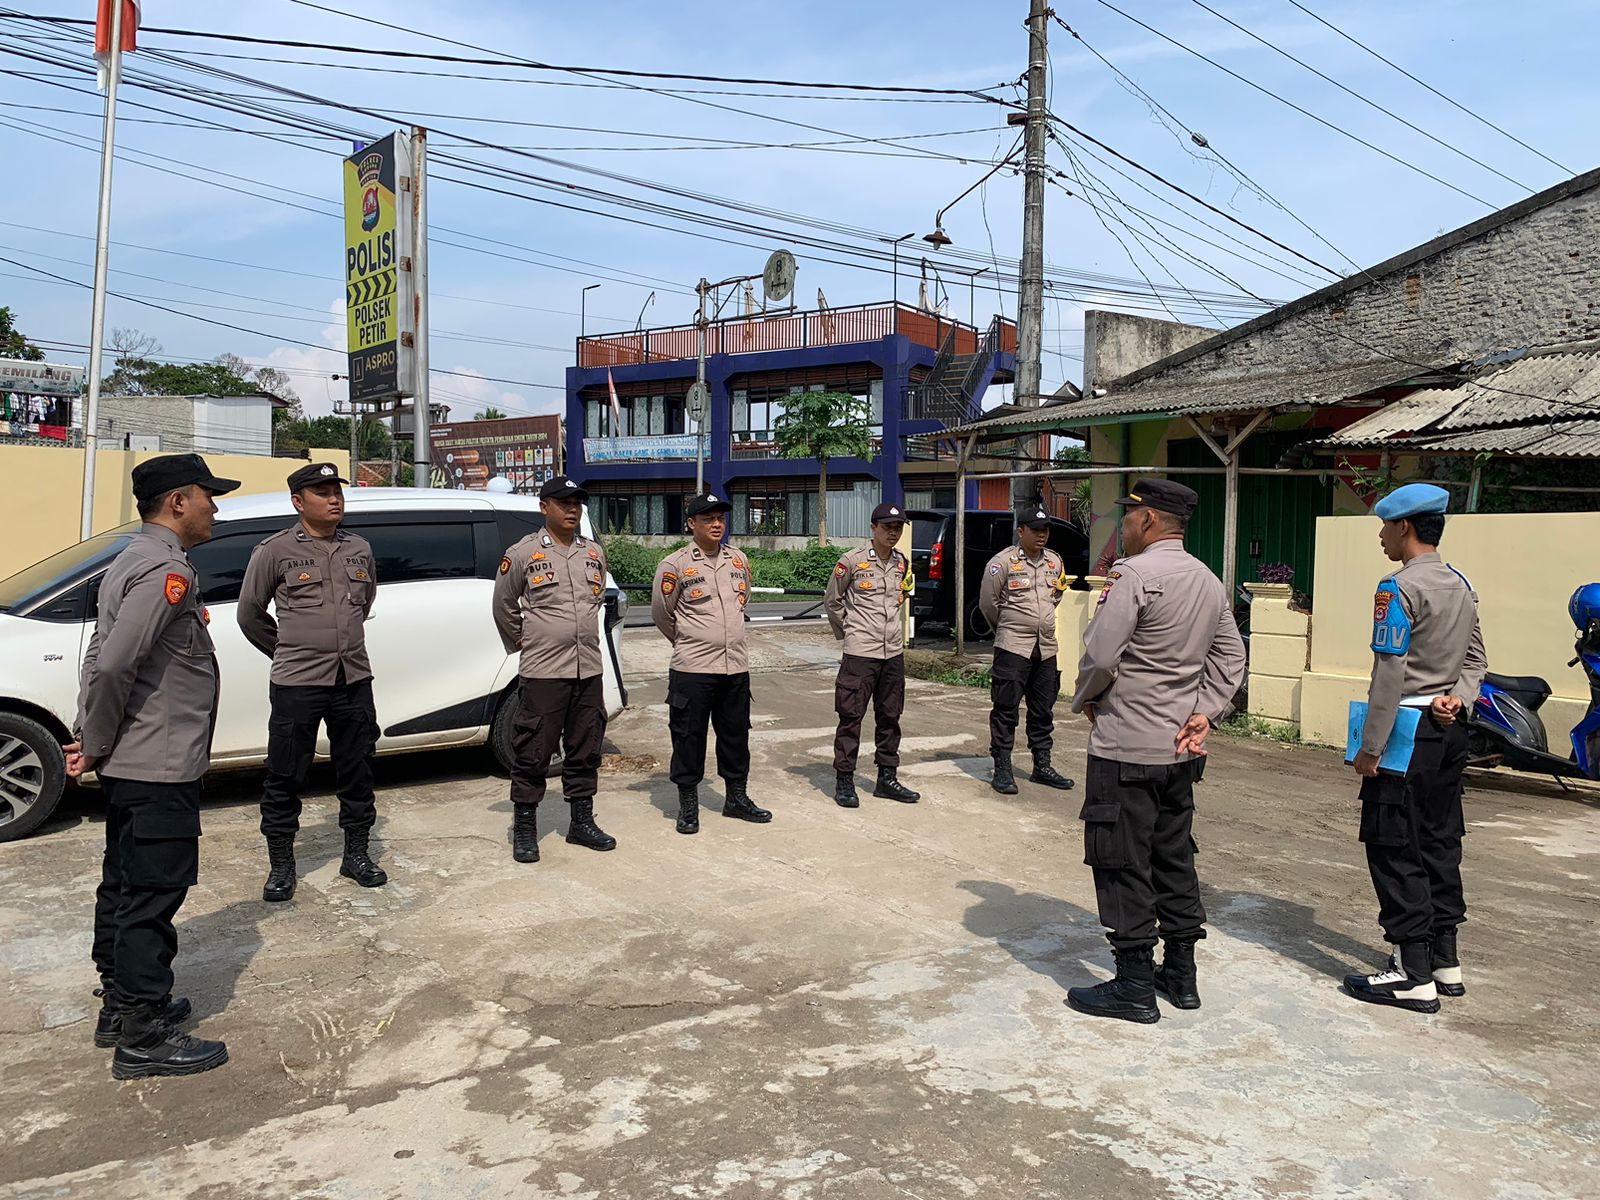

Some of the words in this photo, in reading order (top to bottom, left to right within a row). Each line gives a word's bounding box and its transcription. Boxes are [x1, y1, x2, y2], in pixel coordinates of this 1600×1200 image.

[347, 229, 396, 281] POLISI
[776, 259, 782, 273] 8
[355, 297, 391, 327] POLSEK
[360, 321, 387, 347] PETIR
[365, 350, 396, 371] ASPRO
[0, 367, 72, 381] EMILANG
[693, 390, 699, 401] 8
[287, 559, 315, 570] ANJAR
[528, 562, 553, 574] BUDI
